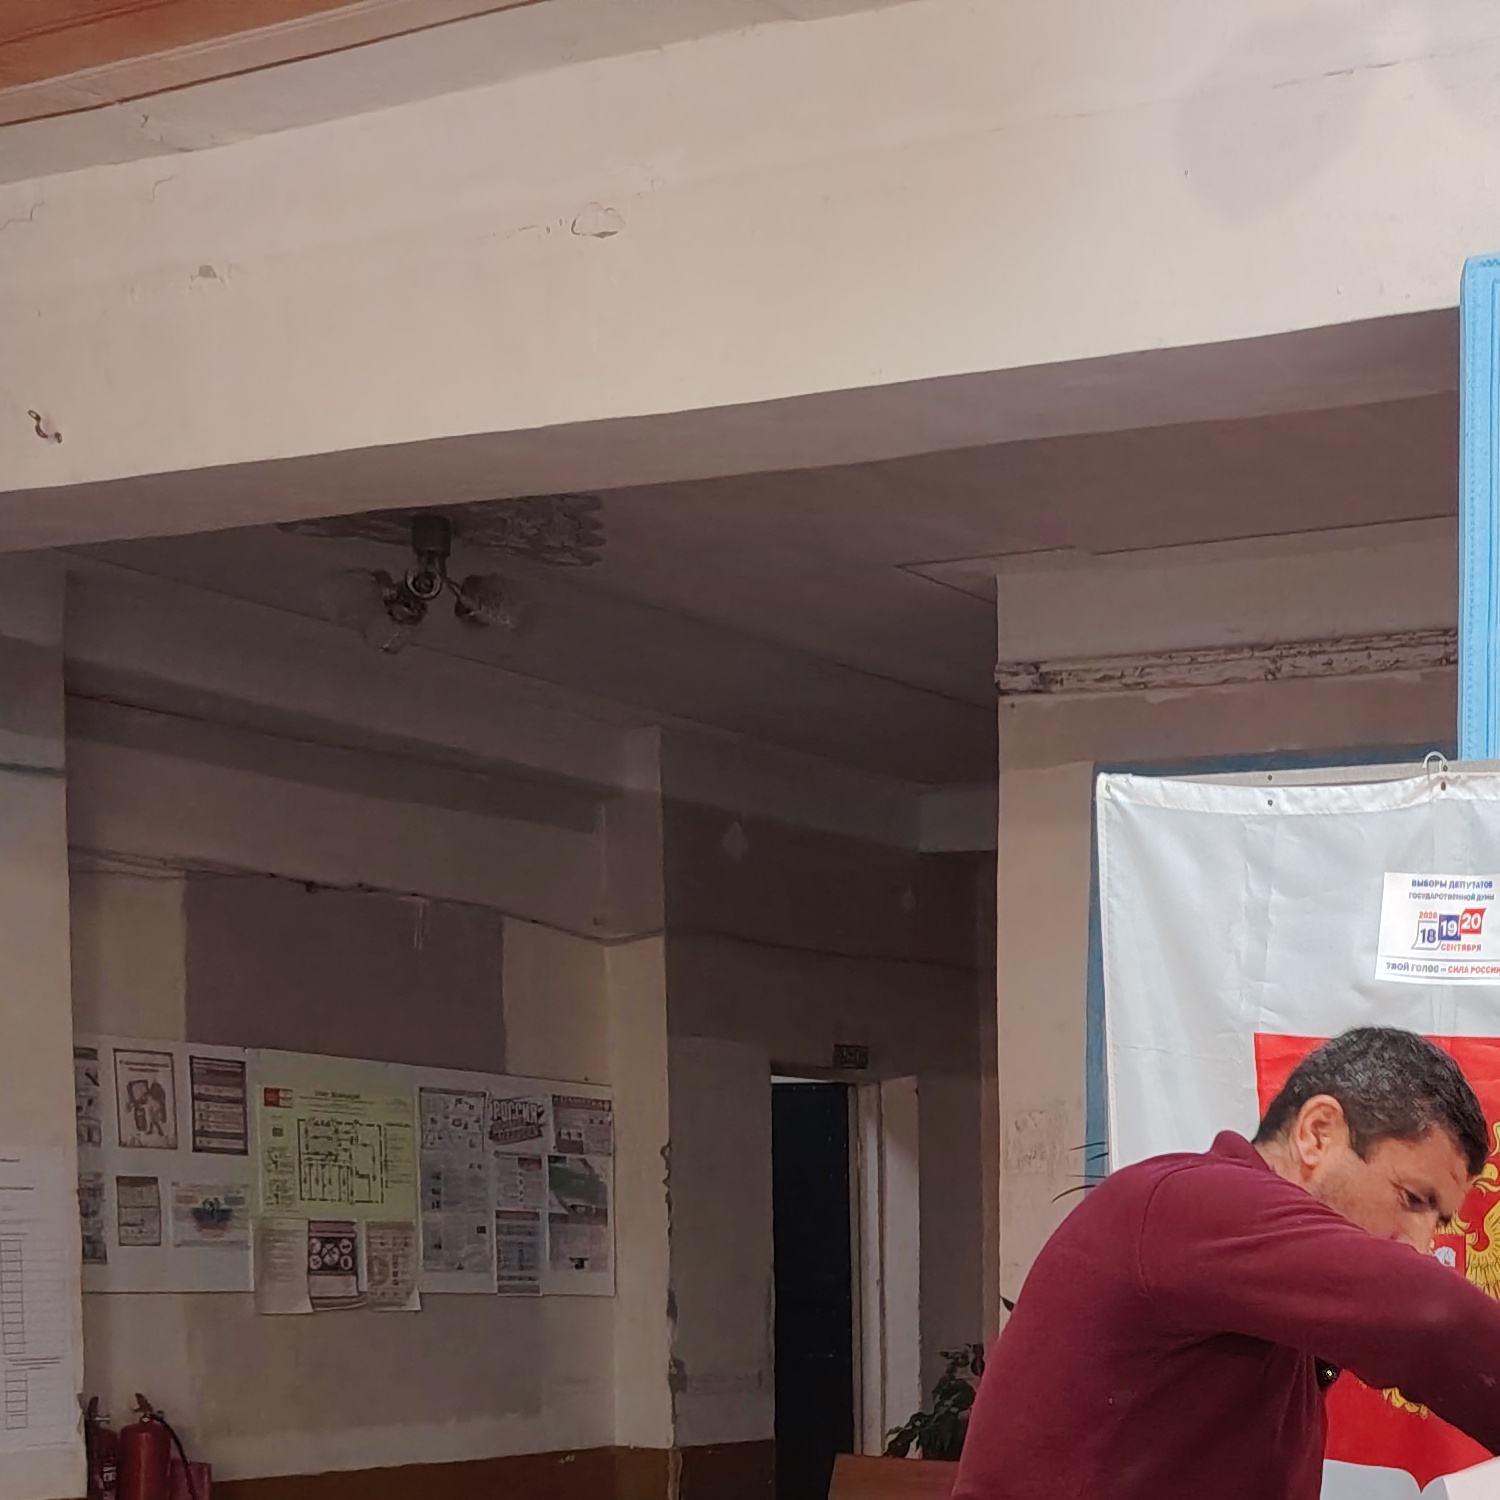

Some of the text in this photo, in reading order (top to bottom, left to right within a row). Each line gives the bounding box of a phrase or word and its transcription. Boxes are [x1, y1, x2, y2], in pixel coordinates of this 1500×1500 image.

[1411, 879, 1493, 890] ВЫБОРЫ ДЕПУТАТОВ
[1420, 913, 1482, 944] 18 19 20
[1440, 943, 1482, 952] СЕНТЯБРЯ
[1386, 962, 1410, 971] ТВОЙ
[1411, 964, 1439, 973] ГОЛОС
[1447, 965, 1469, 974] СИЛА
